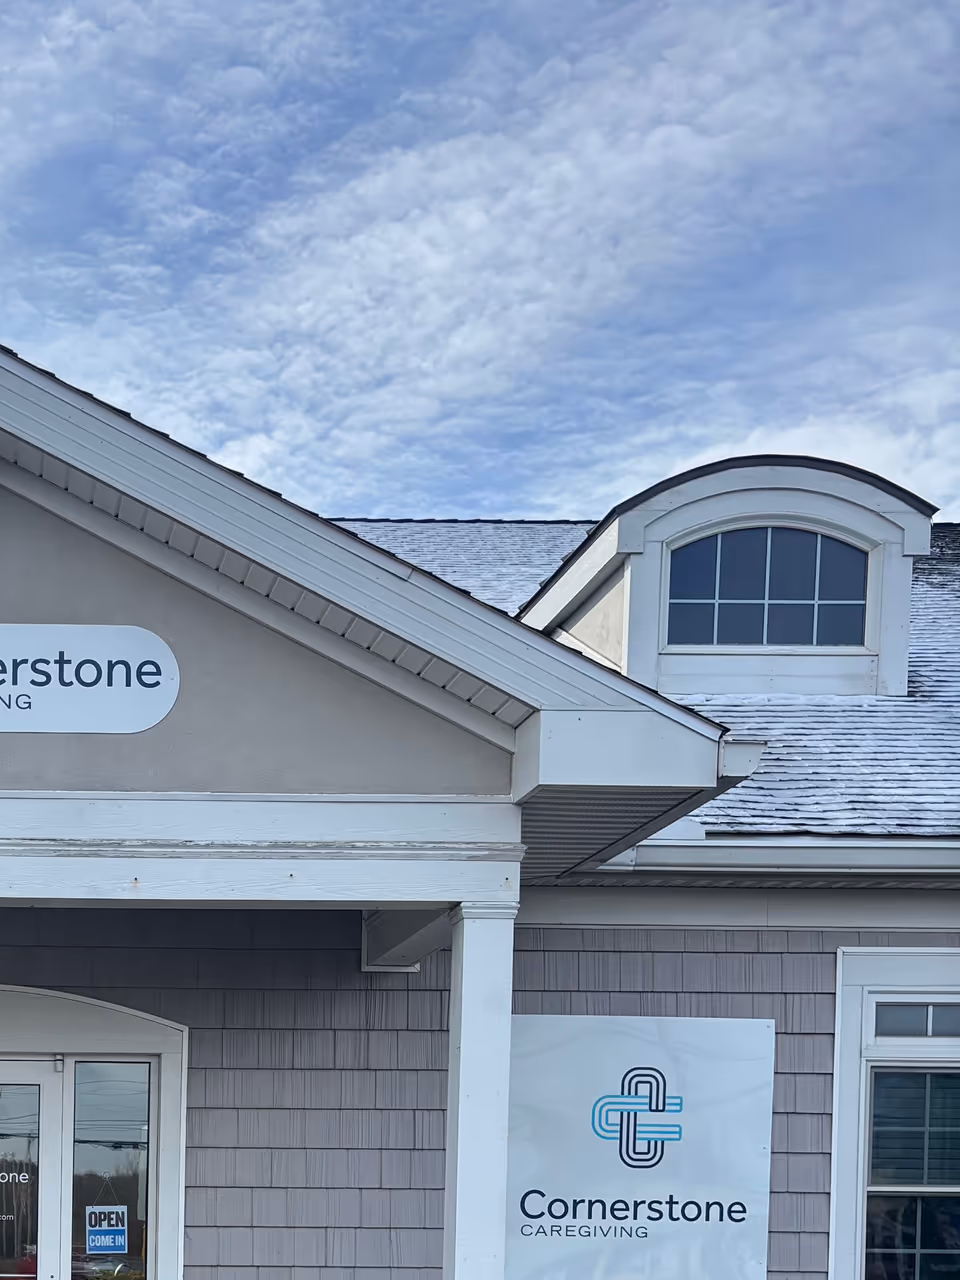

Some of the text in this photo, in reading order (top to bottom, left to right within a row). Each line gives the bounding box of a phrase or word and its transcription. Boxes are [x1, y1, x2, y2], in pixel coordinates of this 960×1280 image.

[519, 1189, 747, 1223] Cornerstone
[88, 1211, 125, 1228] OPEN
[520, 1224, 648, 1239] CAREGIVING
[89, 1235, 124, 1246] COME IN
